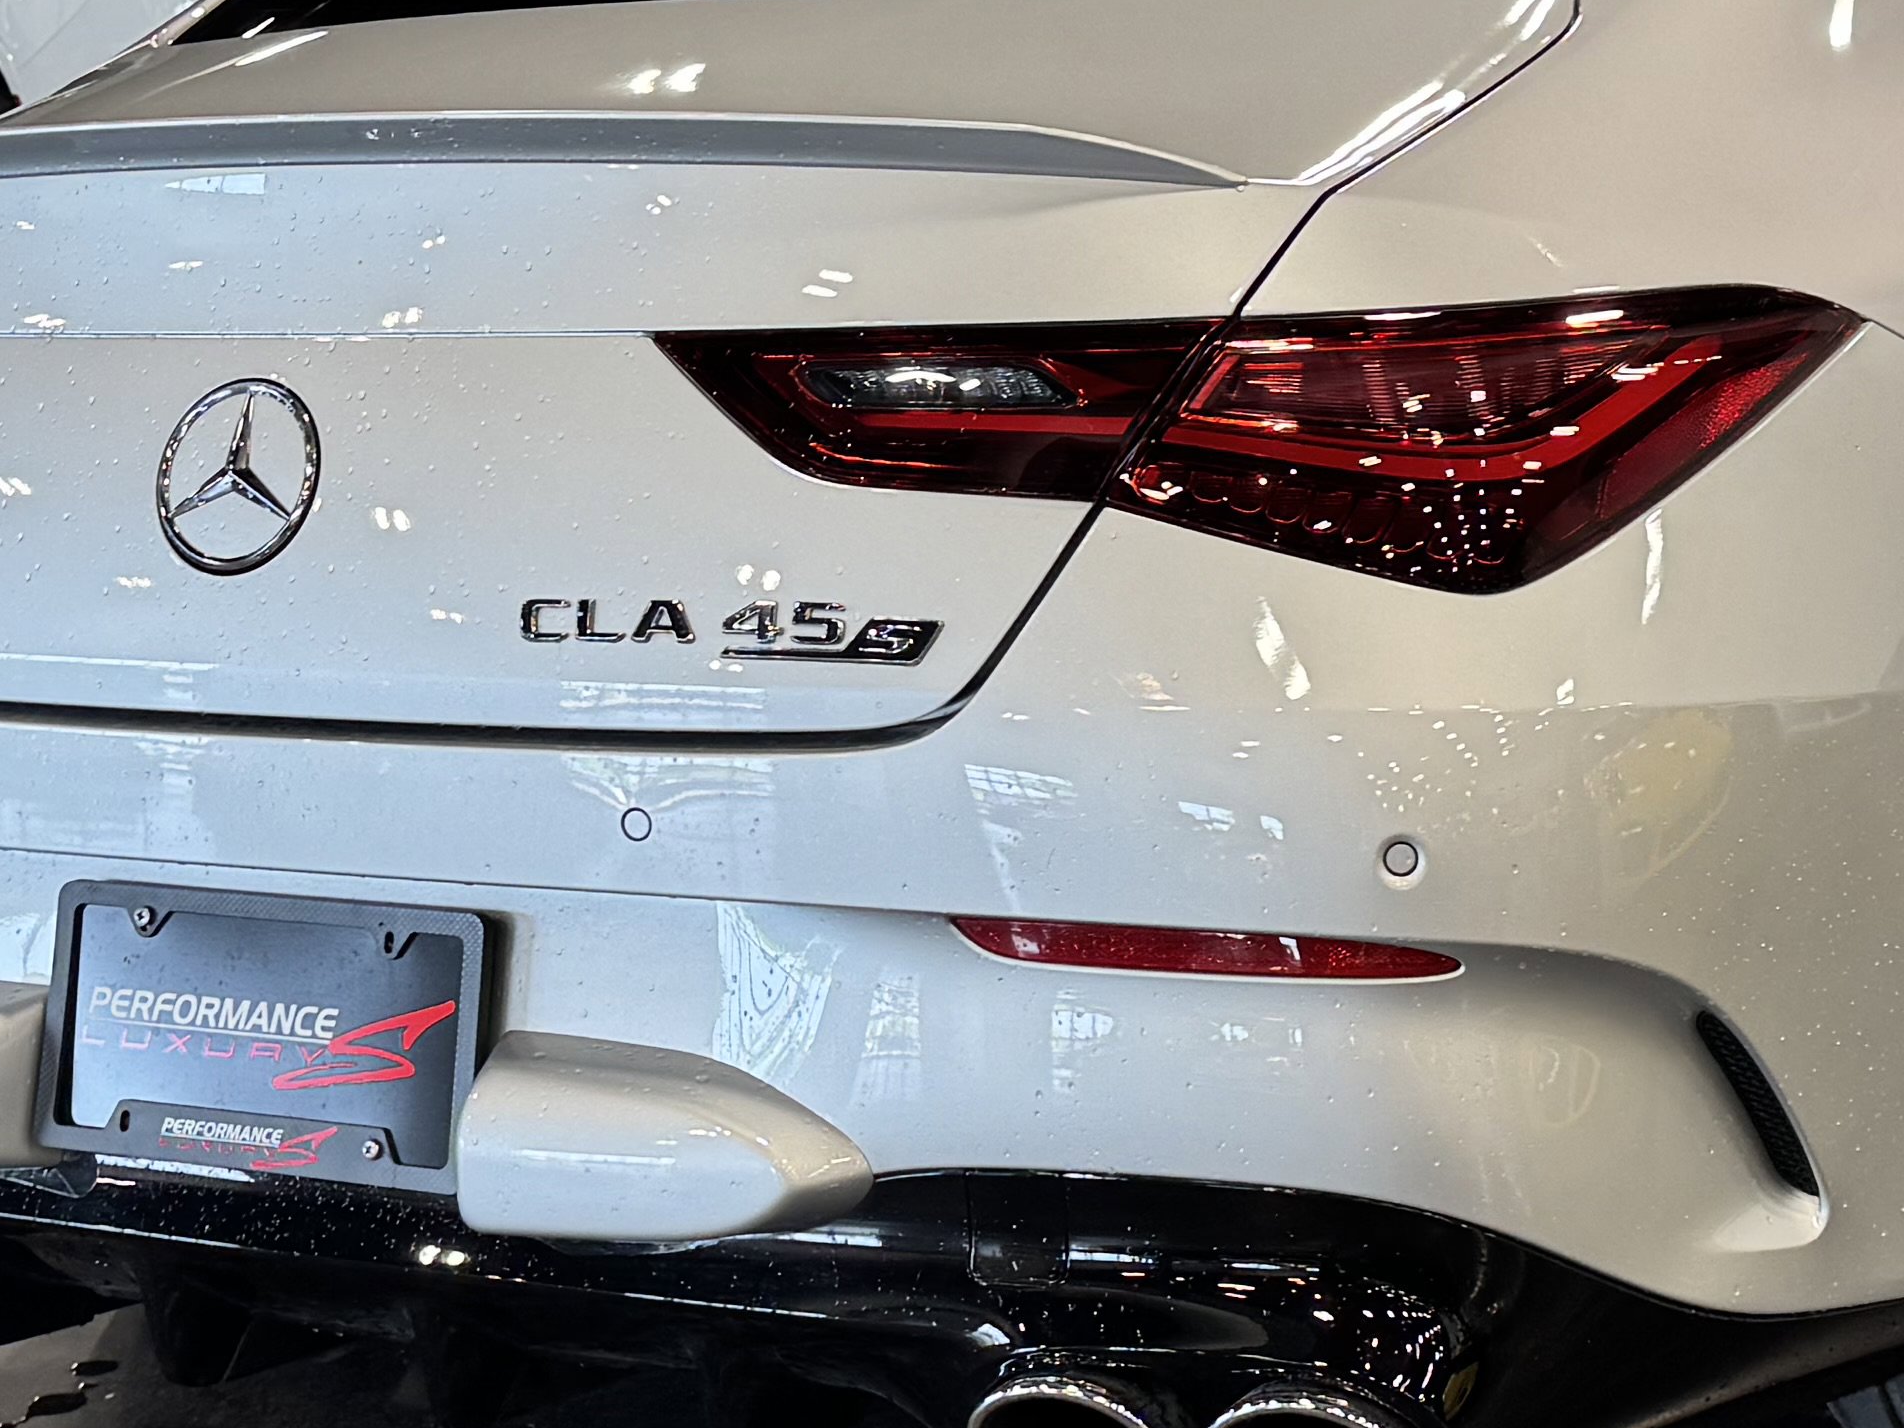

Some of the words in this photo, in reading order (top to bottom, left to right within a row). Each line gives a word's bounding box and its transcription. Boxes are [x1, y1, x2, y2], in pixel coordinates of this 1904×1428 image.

[519, 599, 696, 643] CLA
[721, 599, 847, 644] 45
[89, 986, 340, 1038] PERFORMANCE
[80, 1025, 328, 1066] LUXURY
[161, 1117, 284, 1144] PERFORMANCE
